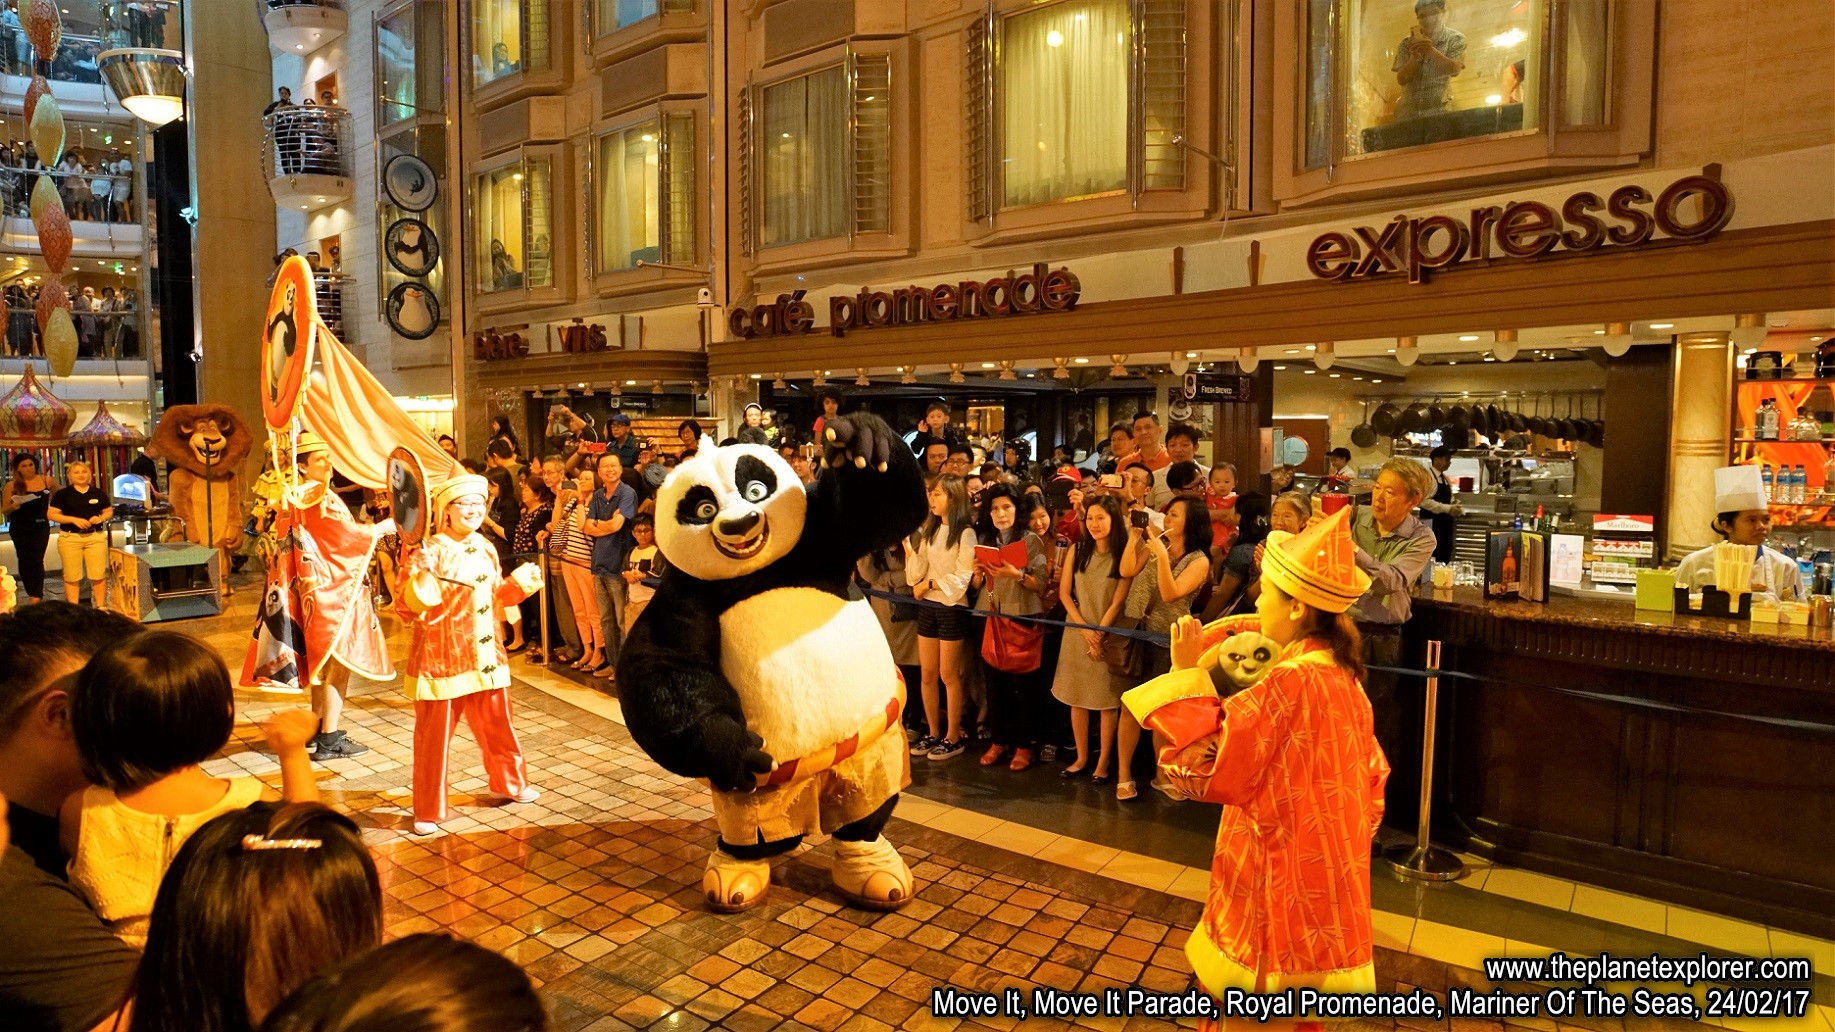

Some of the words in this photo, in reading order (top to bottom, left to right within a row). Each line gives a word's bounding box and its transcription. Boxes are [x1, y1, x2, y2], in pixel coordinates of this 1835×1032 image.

[1306, 174, 1735, 284] expresso
[729, 289, 814, 338] café
[829, 262, 1082, 337] promenade
[1606, 521, 1640, 529] Marlboro
